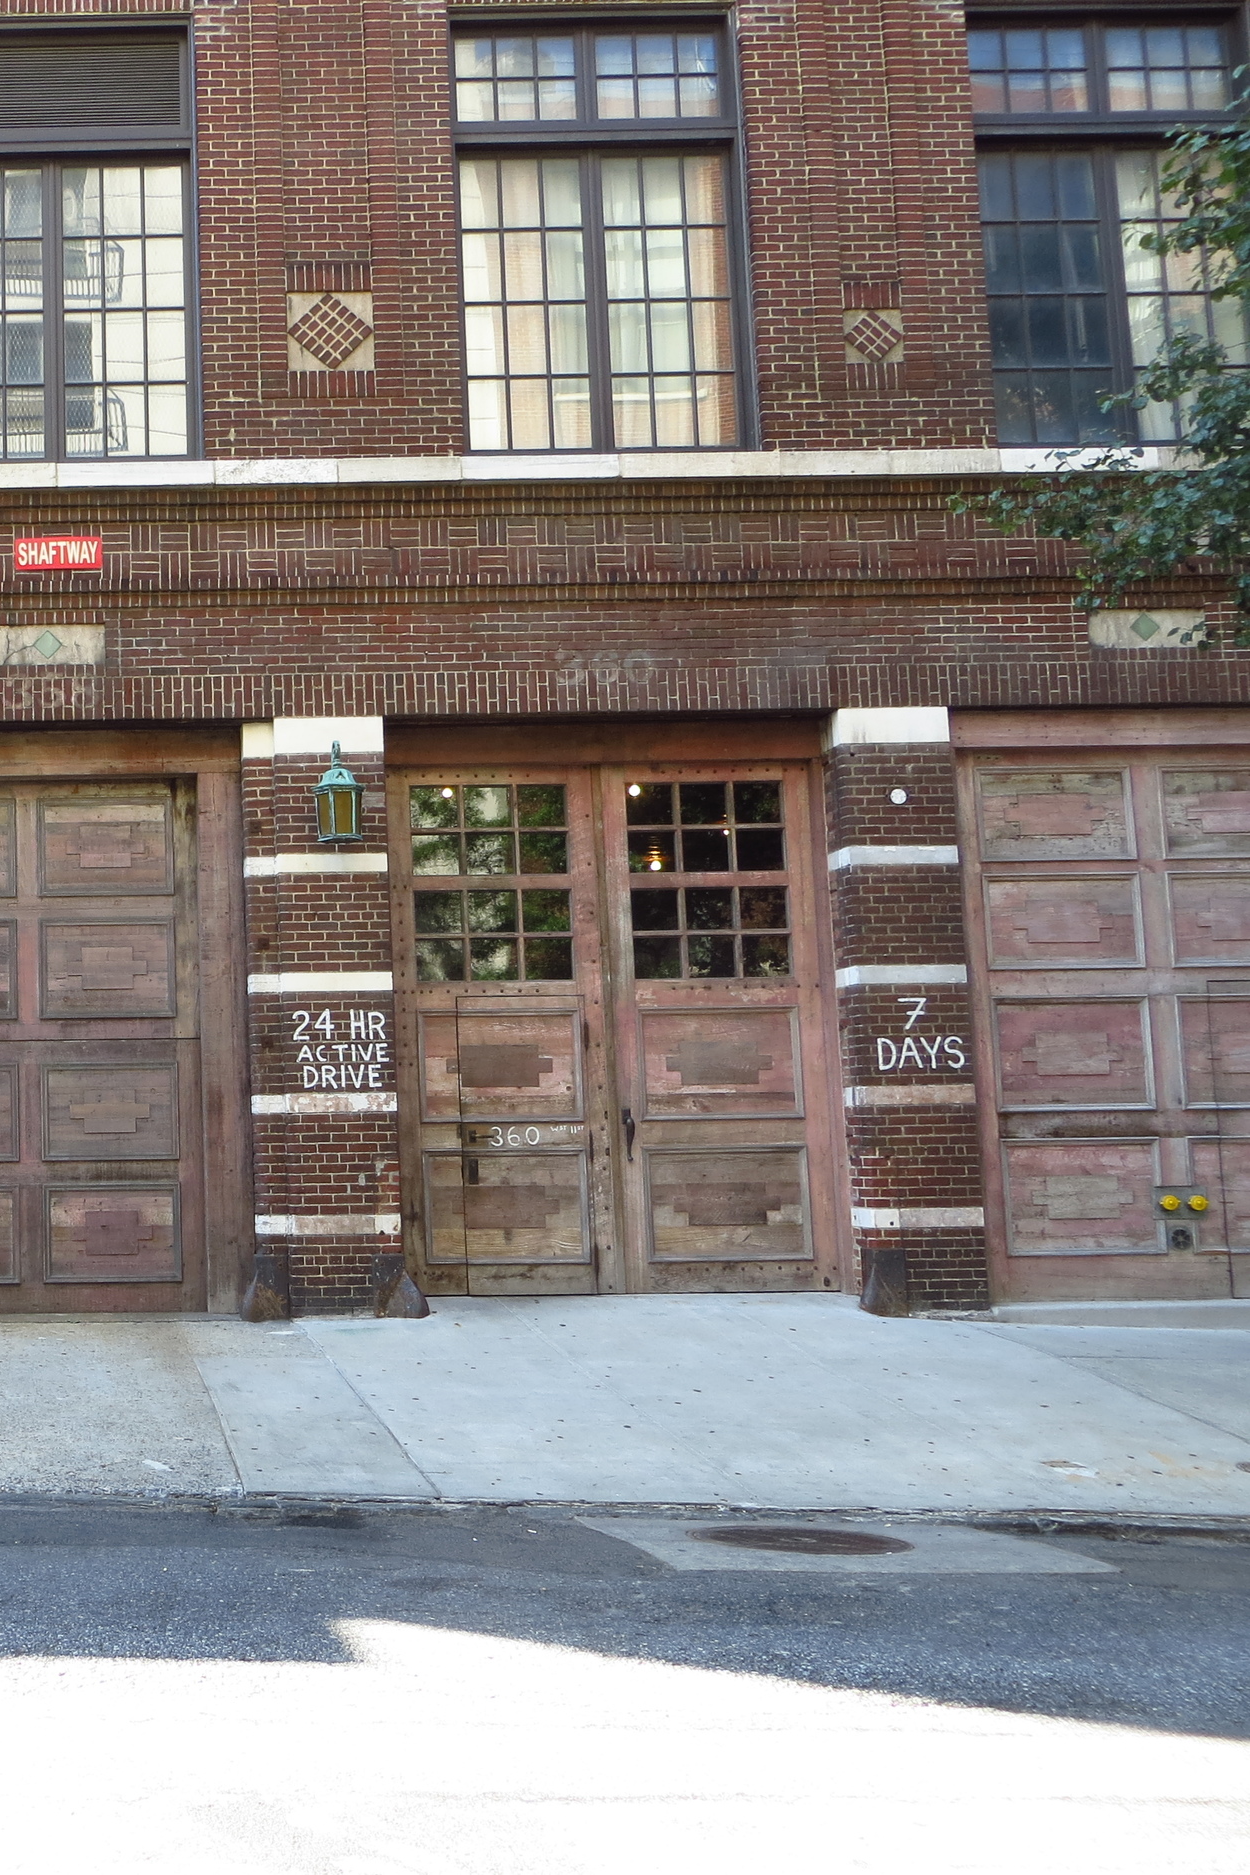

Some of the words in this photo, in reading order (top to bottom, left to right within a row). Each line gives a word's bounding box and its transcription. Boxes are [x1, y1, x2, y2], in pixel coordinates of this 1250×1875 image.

[18, 541, 98, 566] SHAFTWAY
[291, 1008, 335, 1041] 24
[349, 1008, 386, 1040] HR
[897, 997, 927, 1030] 7
[296, 1043, 390, 1063] ACTIVE
[876, 1036, 966, 1071] DAYS
[302, 1064, 383, 1090] DRIVE
[490, 1126, 540, 1147] 360
